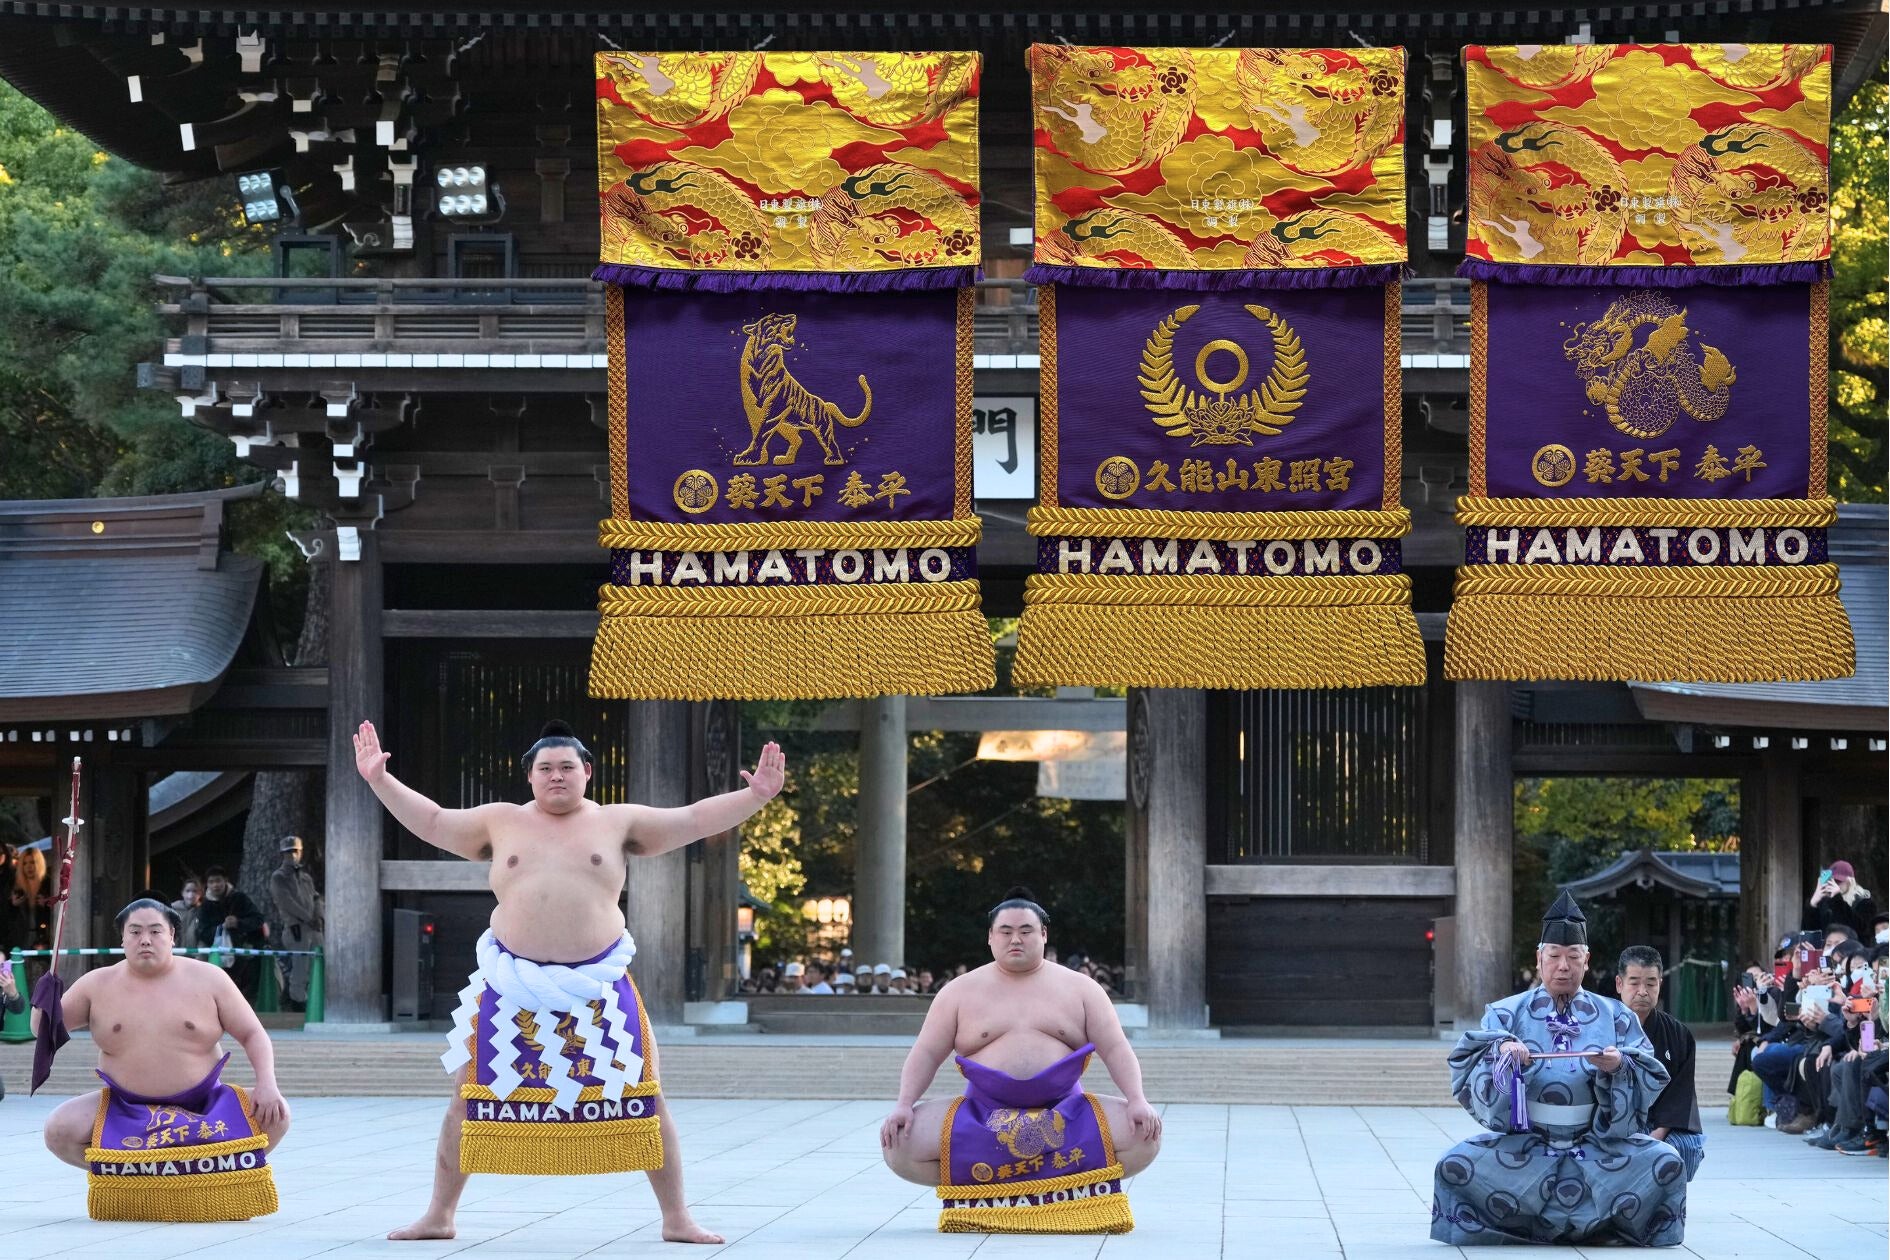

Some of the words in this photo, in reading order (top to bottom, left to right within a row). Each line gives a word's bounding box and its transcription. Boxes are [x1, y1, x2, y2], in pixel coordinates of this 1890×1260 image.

[973, 407, 1019, 474] 門
[1143, 457, 1355, 493] 久能山東照宮
[1693, 444, 1768, 483] 泰平
[837, 470, 912, 510] 泰平
[1058, 539, 1383, 575] HAMATOMO
[1486, 528, 1810, 564] HAMATOMO
[629, 549, 952, 586] HAMATOMO
[477, 1098, 645, 1122] HAMATOMO
[100, 1151, 258, 1176] HAMATOMO
[954, 1182, 1111, 1209] HAMATOMO
